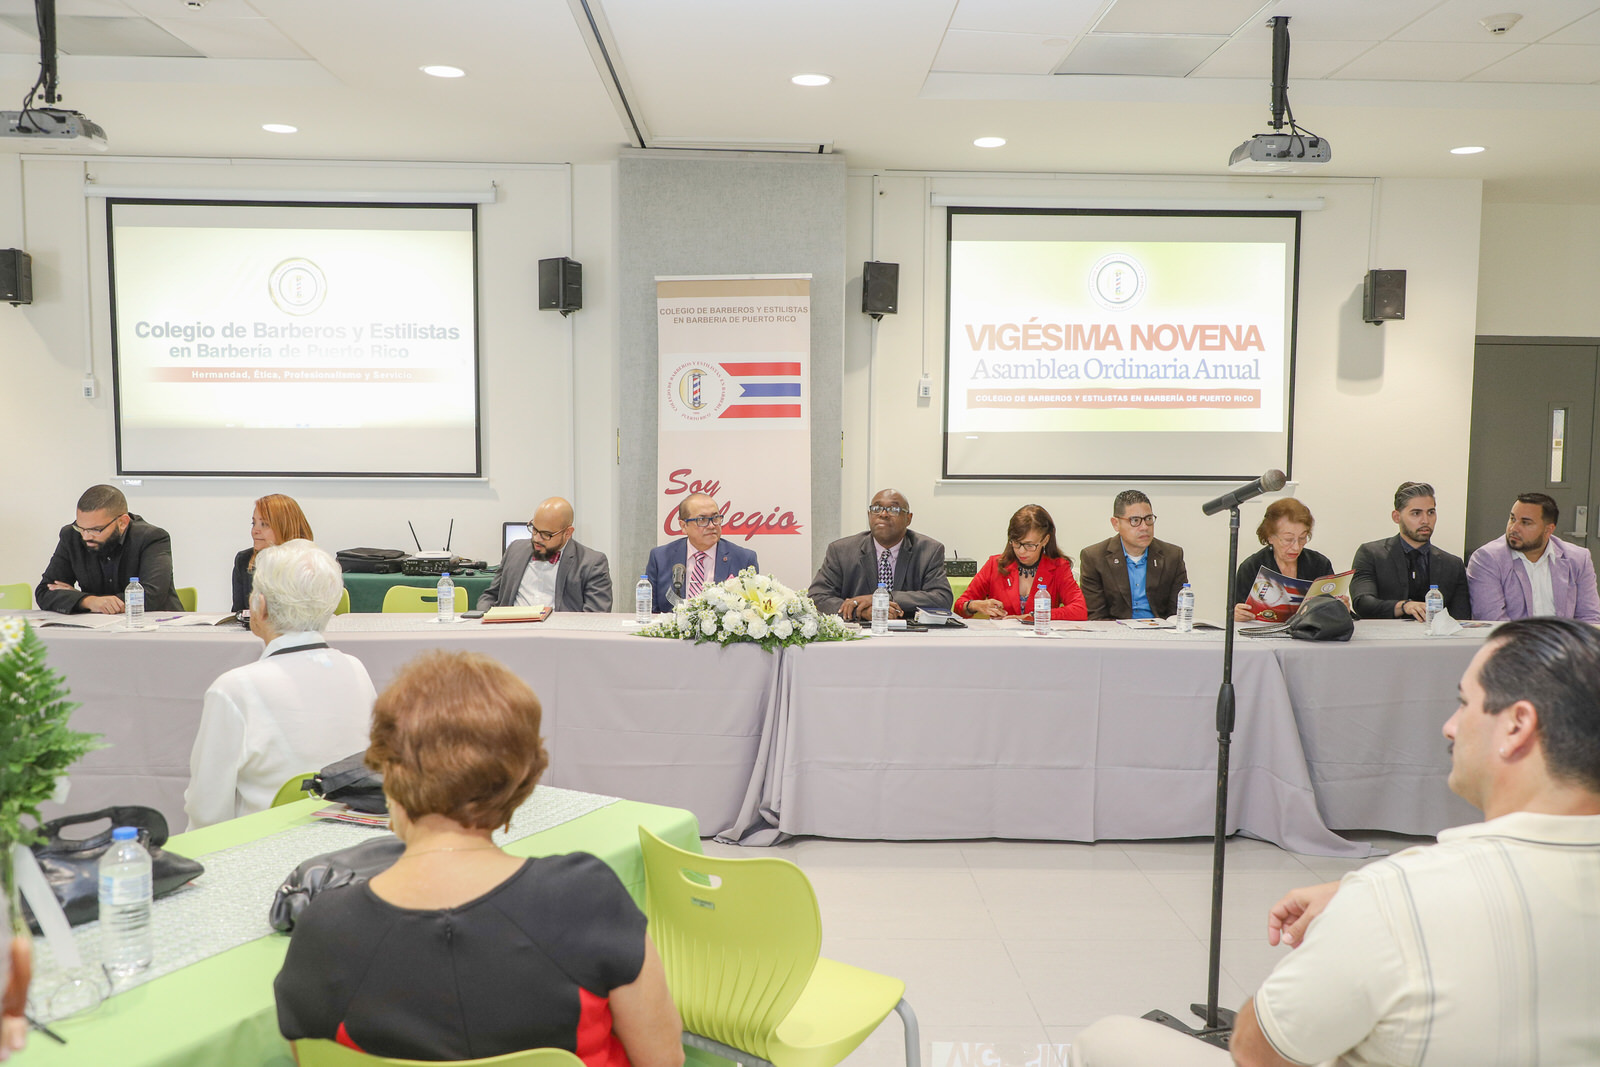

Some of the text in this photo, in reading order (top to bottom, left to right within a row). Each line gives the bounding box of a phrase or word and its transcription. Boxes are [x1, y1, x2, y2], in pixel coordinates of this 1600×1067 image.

[660, 307, 695, 315] COLEGIO
[710, 306, 755, 314] BARBEROS
[135, 321, 460, 342] Colegio de Barberos y Estilistas
[965, 316, 1266, 352] VIGÉSIMA NOVENA
[169, 344, 409, 358] en Barbería de Puerto Rico
[192, 369, 412, 380] Hermandad, Ética, Profesionalismo y Servicio
[970, 358, 1260, 380] Asamblea Ordinaria Anual
[1074, 394, 1080, 402] Y
[1082, 394, 1128, 402] ESTILISTAS
[1130, 394, 1142, 402] EN
[1144, 393, 1184, 402] BARBERÍA
[1186, 394, 1198, 402] DE
[1200, 394, 1232, 402] PUERTO
[664, 468, 722, 498] Soy
[664, 500, 798, 542] Clegio
